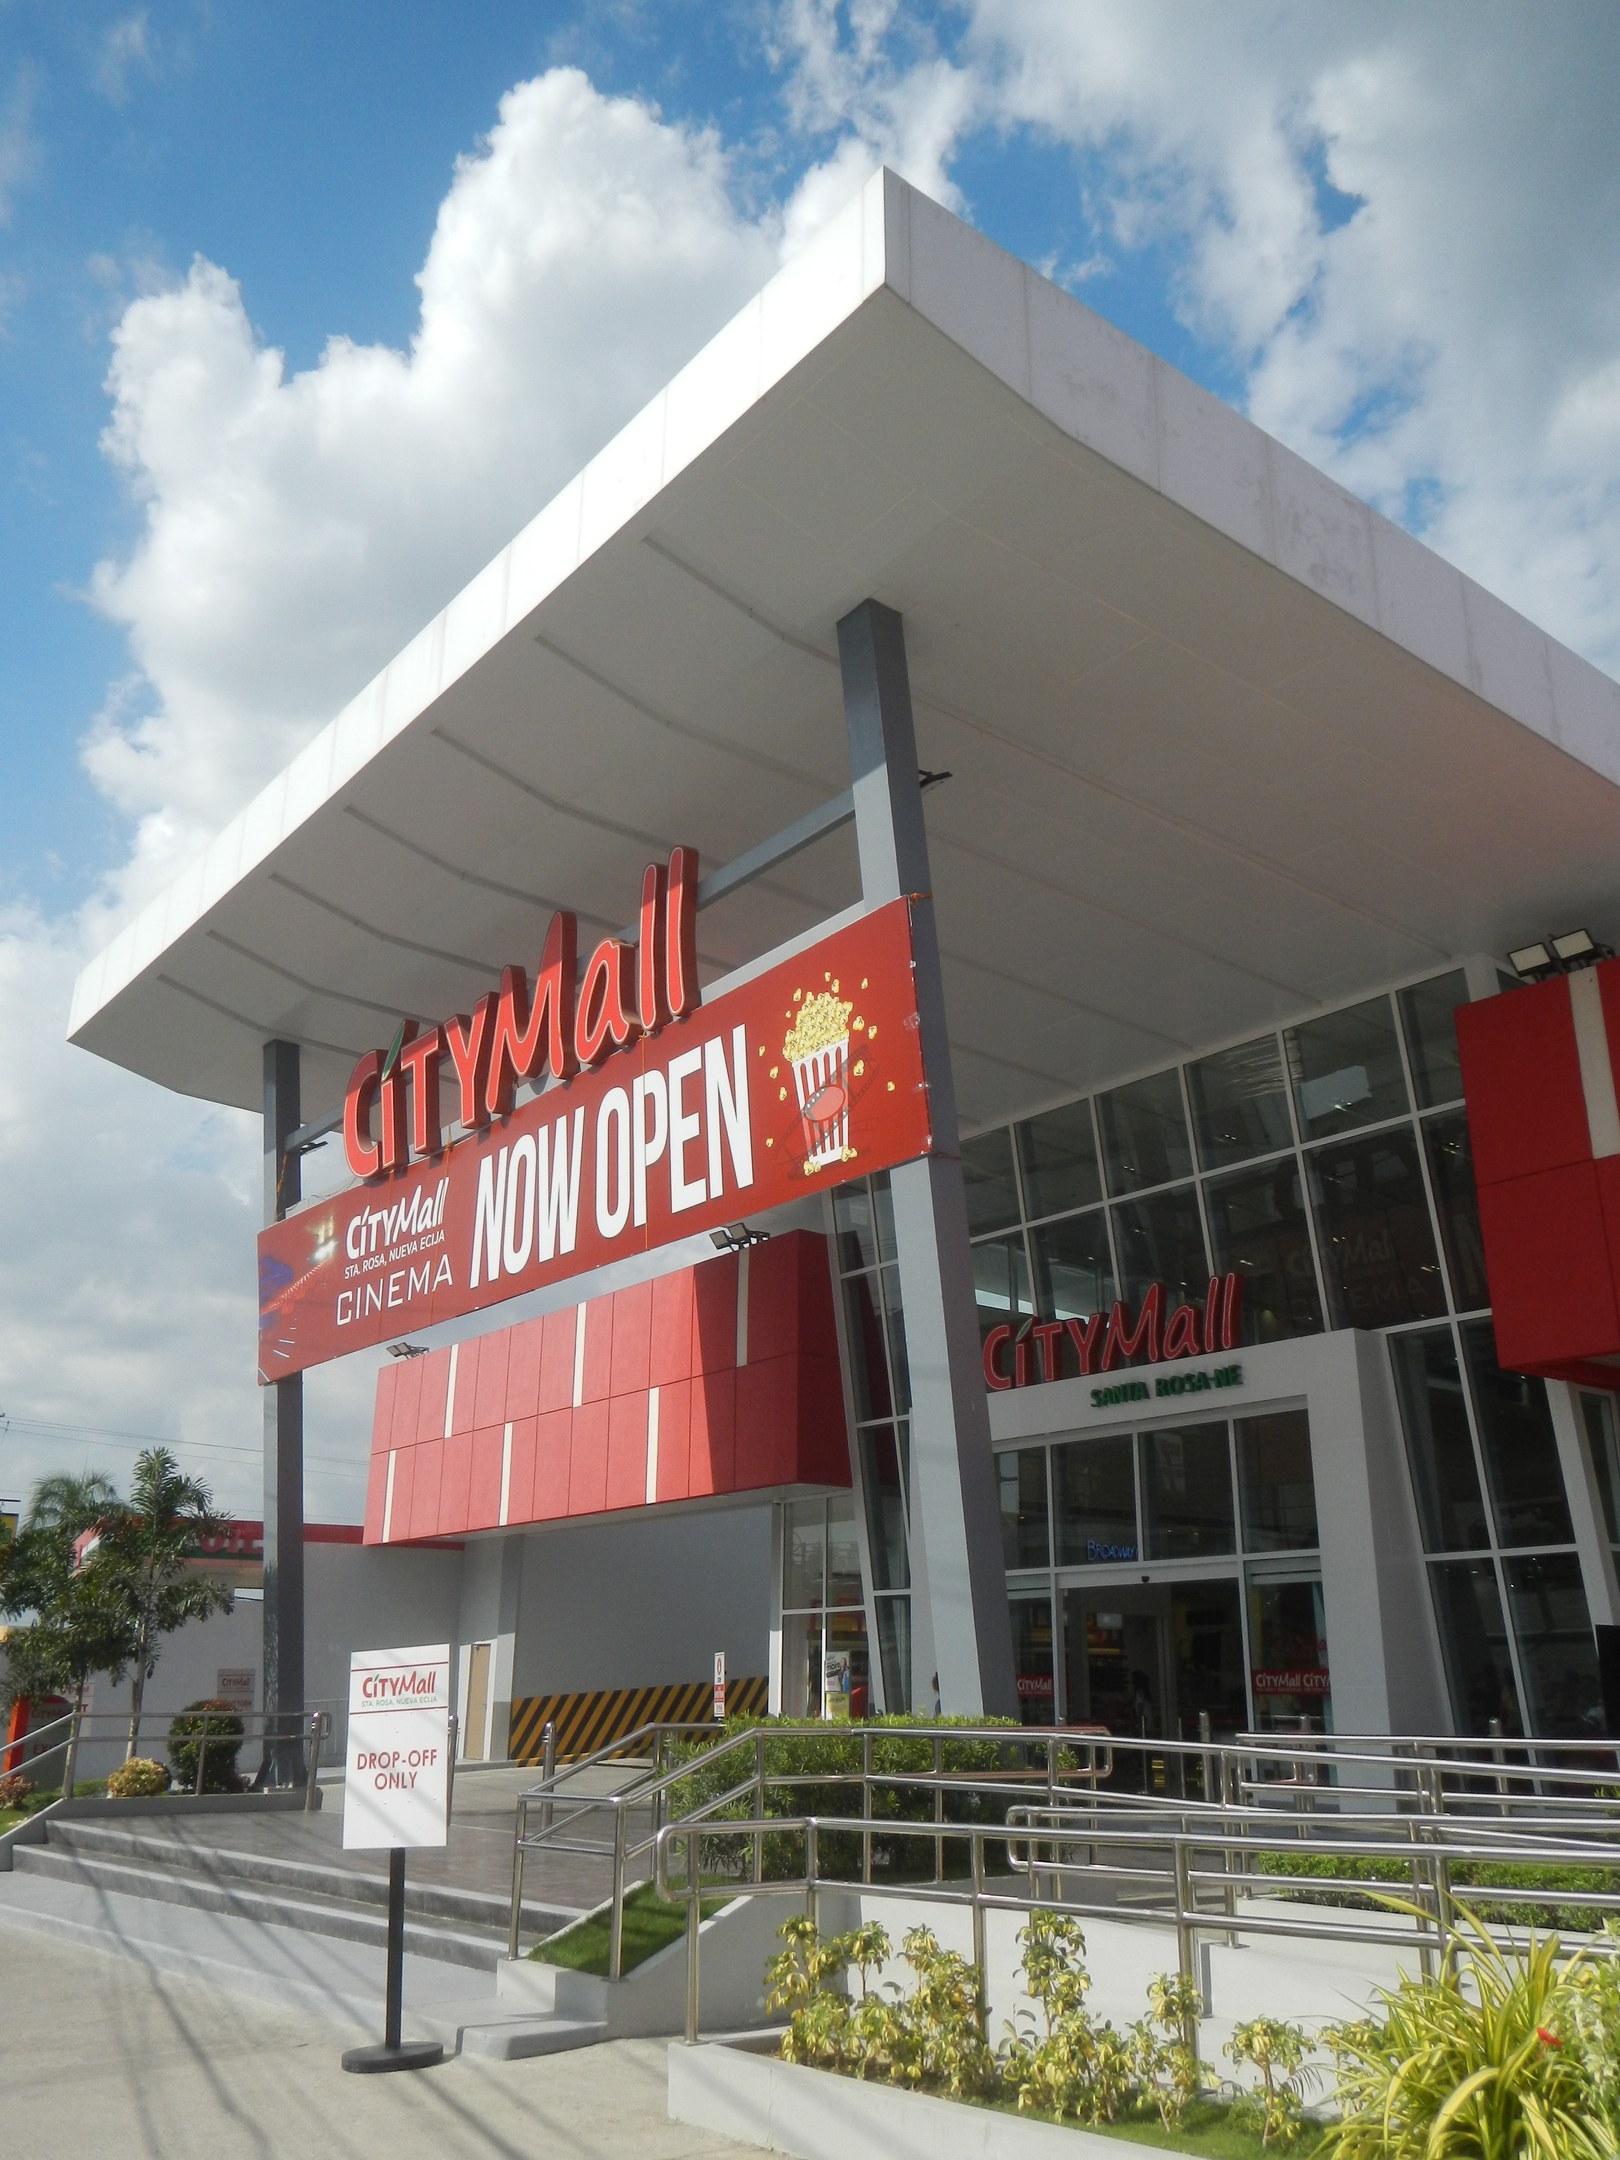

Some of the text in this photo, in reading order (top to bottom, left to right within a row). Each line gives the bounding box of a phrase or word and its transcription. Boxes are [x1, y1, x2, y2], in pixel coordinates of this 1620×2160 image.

[469, 1023, 756, 1289] NOW OPEN
[344, 1229, 445, 1280] STA. ROSA, NUEVA ECIJA
[336, 1253, 454, 1326] CINEMA
[1090, 1364, 1244, 1409] SANTA ROSA-NE
[396, 1697, 418, 1705] NUEVA
[419, 1695, 438, 1703] ECIJA
[357, 1749, 438, 1770] DROP-OFF
[374, 1771, 418, 1790] ONLY
